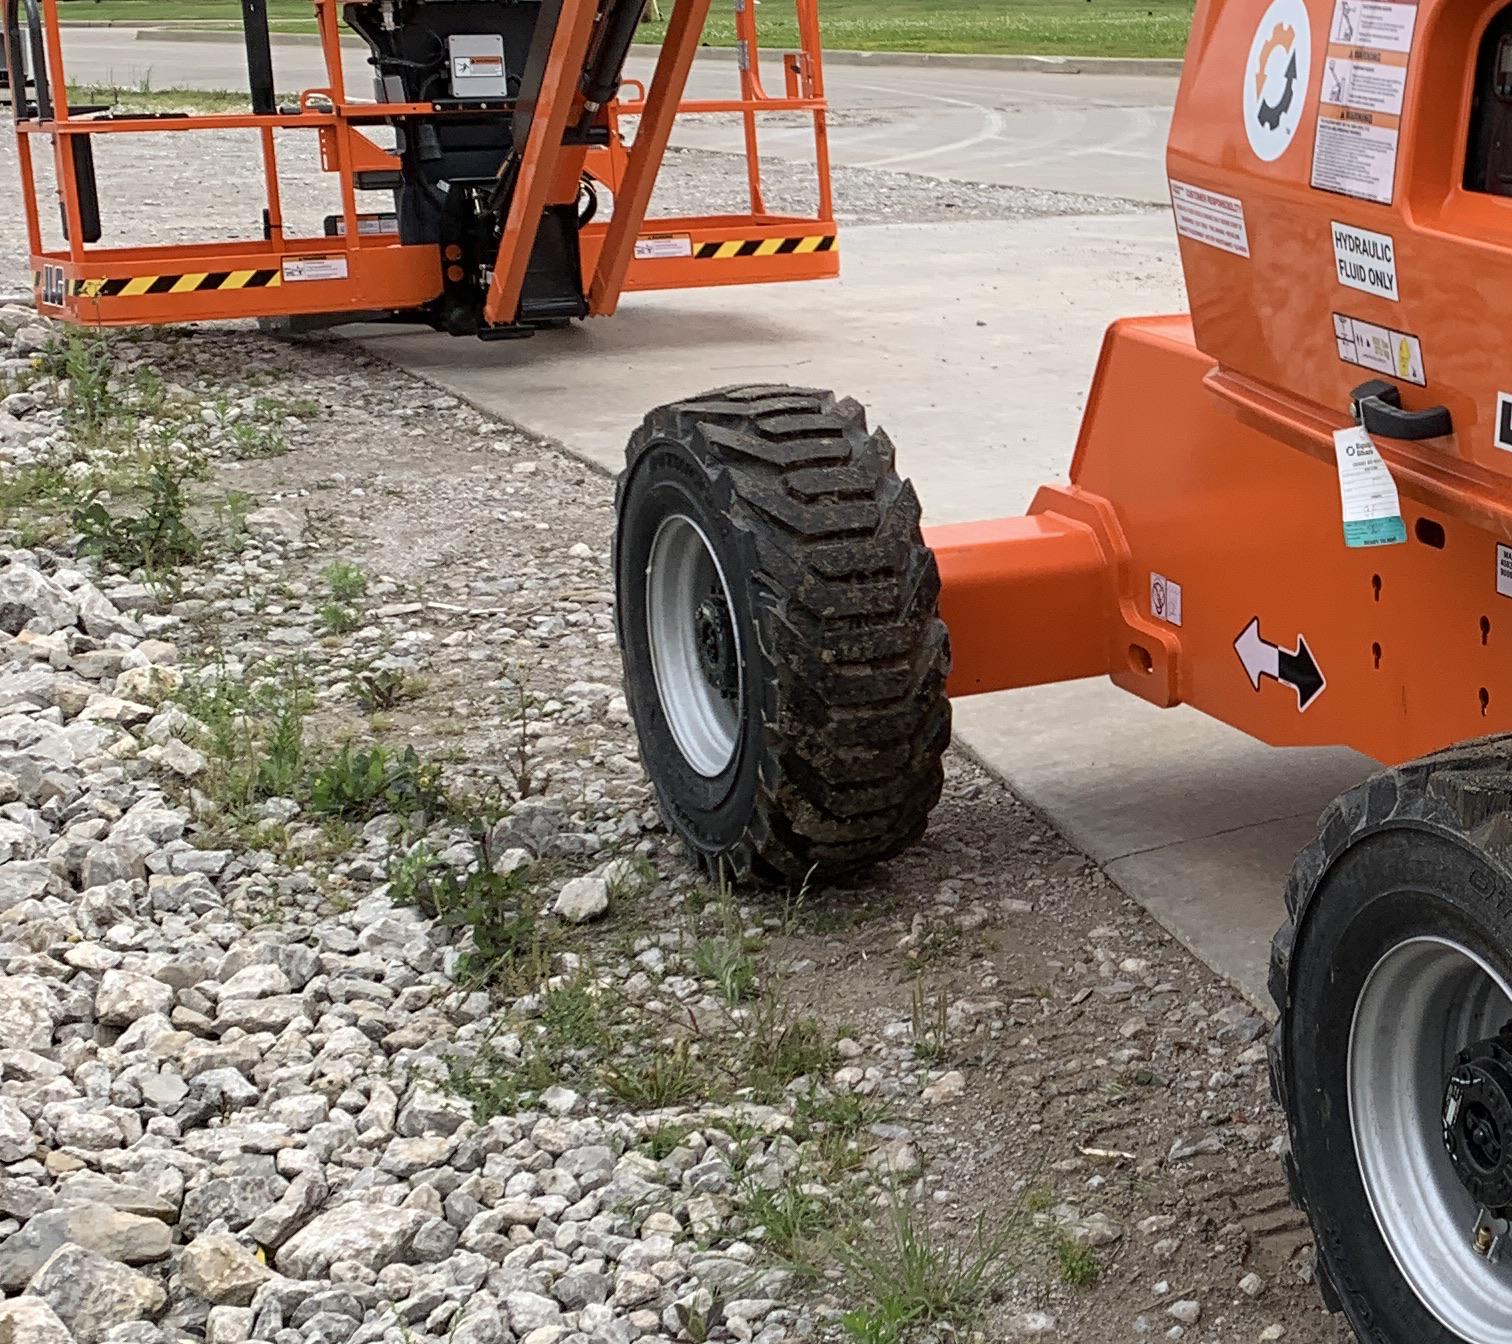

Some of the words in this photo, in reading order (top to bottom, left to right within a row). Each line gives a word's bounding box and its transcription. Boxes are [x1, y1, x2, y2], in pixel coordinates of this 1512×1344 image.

[1335, 231, 1392, 263] HYDRAULIC
[1338, 259, 1366, 283] FLUID
[1368, 268, 1394, 292] ONLY
